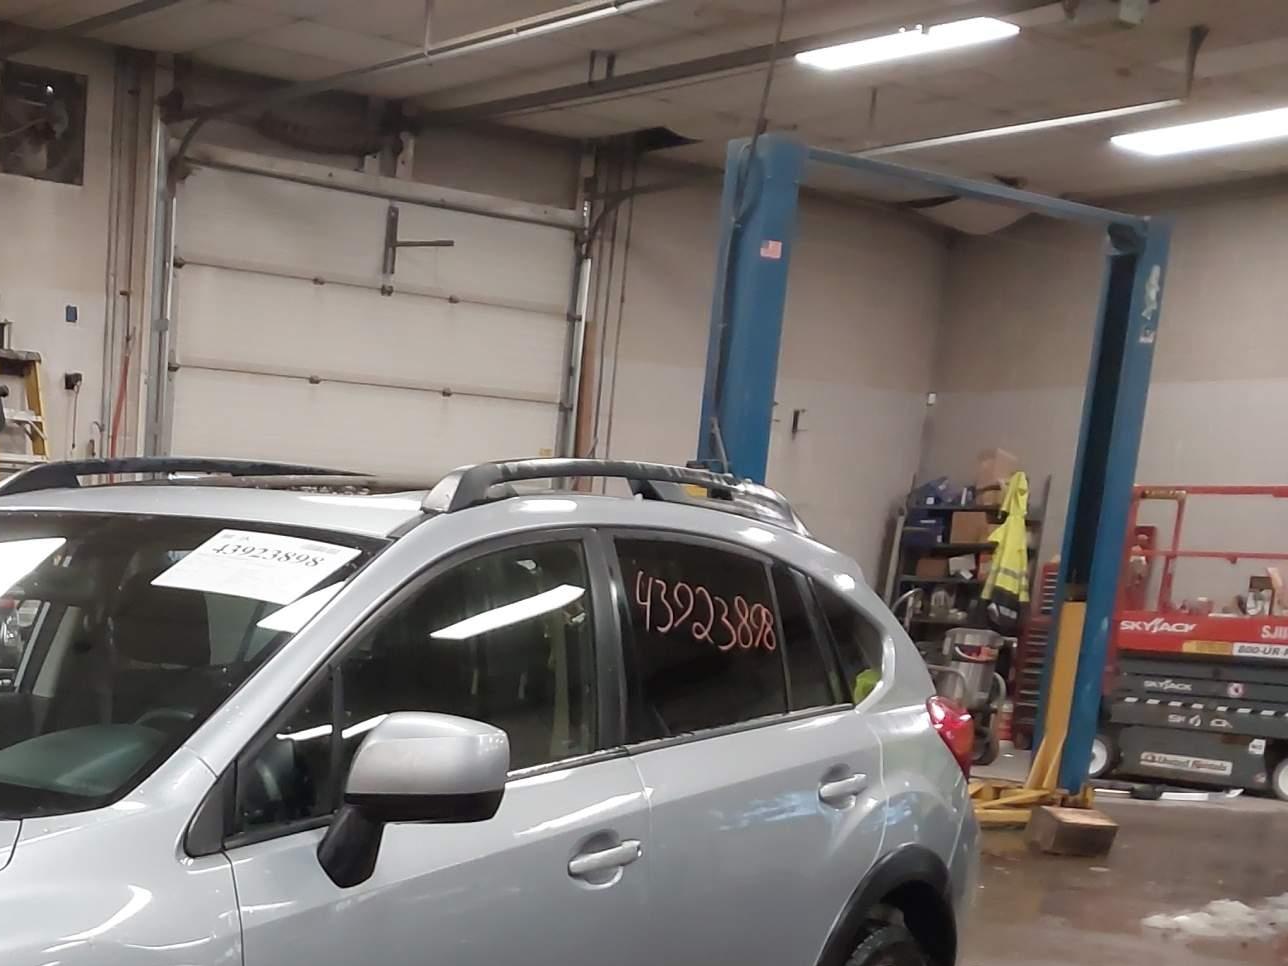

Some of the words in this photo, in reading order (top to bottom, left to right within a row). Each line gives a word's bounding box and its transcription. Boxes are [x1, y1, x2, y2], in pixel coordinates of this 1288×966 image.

[212, 543, 326, 568] 43923898
[635, 569, 777, 651] 43923898
[1143, 679, 1193, 692] SKYJACK
